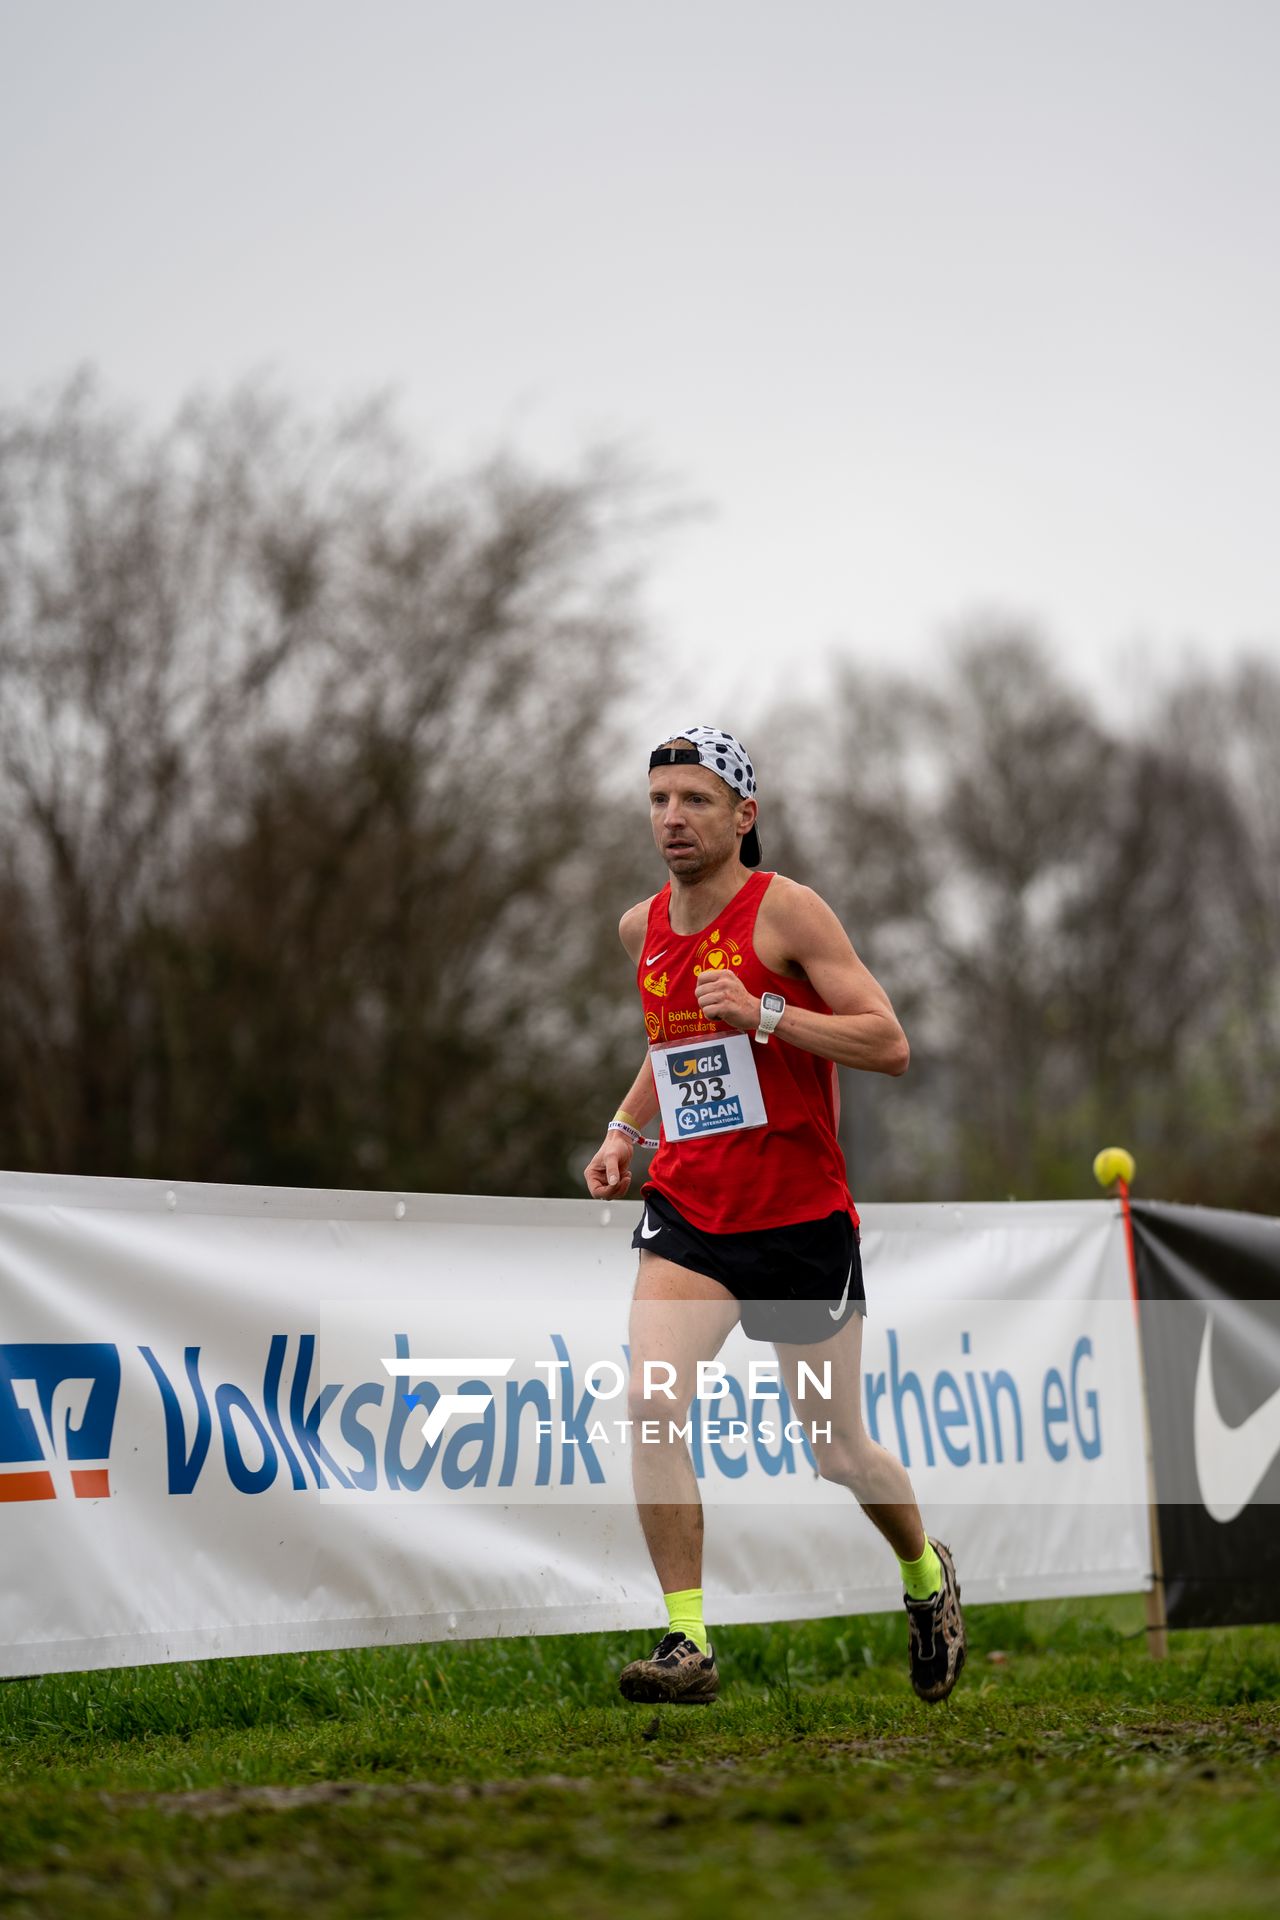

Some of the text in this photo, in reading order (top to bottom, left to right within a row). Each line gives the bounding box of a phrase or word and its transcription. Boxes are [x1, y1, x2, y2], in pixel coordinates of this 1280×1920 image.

[668, 1010, 698, 1022] Böhke
[697, 1054, 723, 1073] GLS
[678, 1077, 727, 1107] 293
[700, 1102, 739, 1120] PLAN
[702, 1116, 740, 1127] INTERNATIONAL
[137, 1334, 606, 1495] Volksbank
[1042, 1336, 1102, 1462] eG
